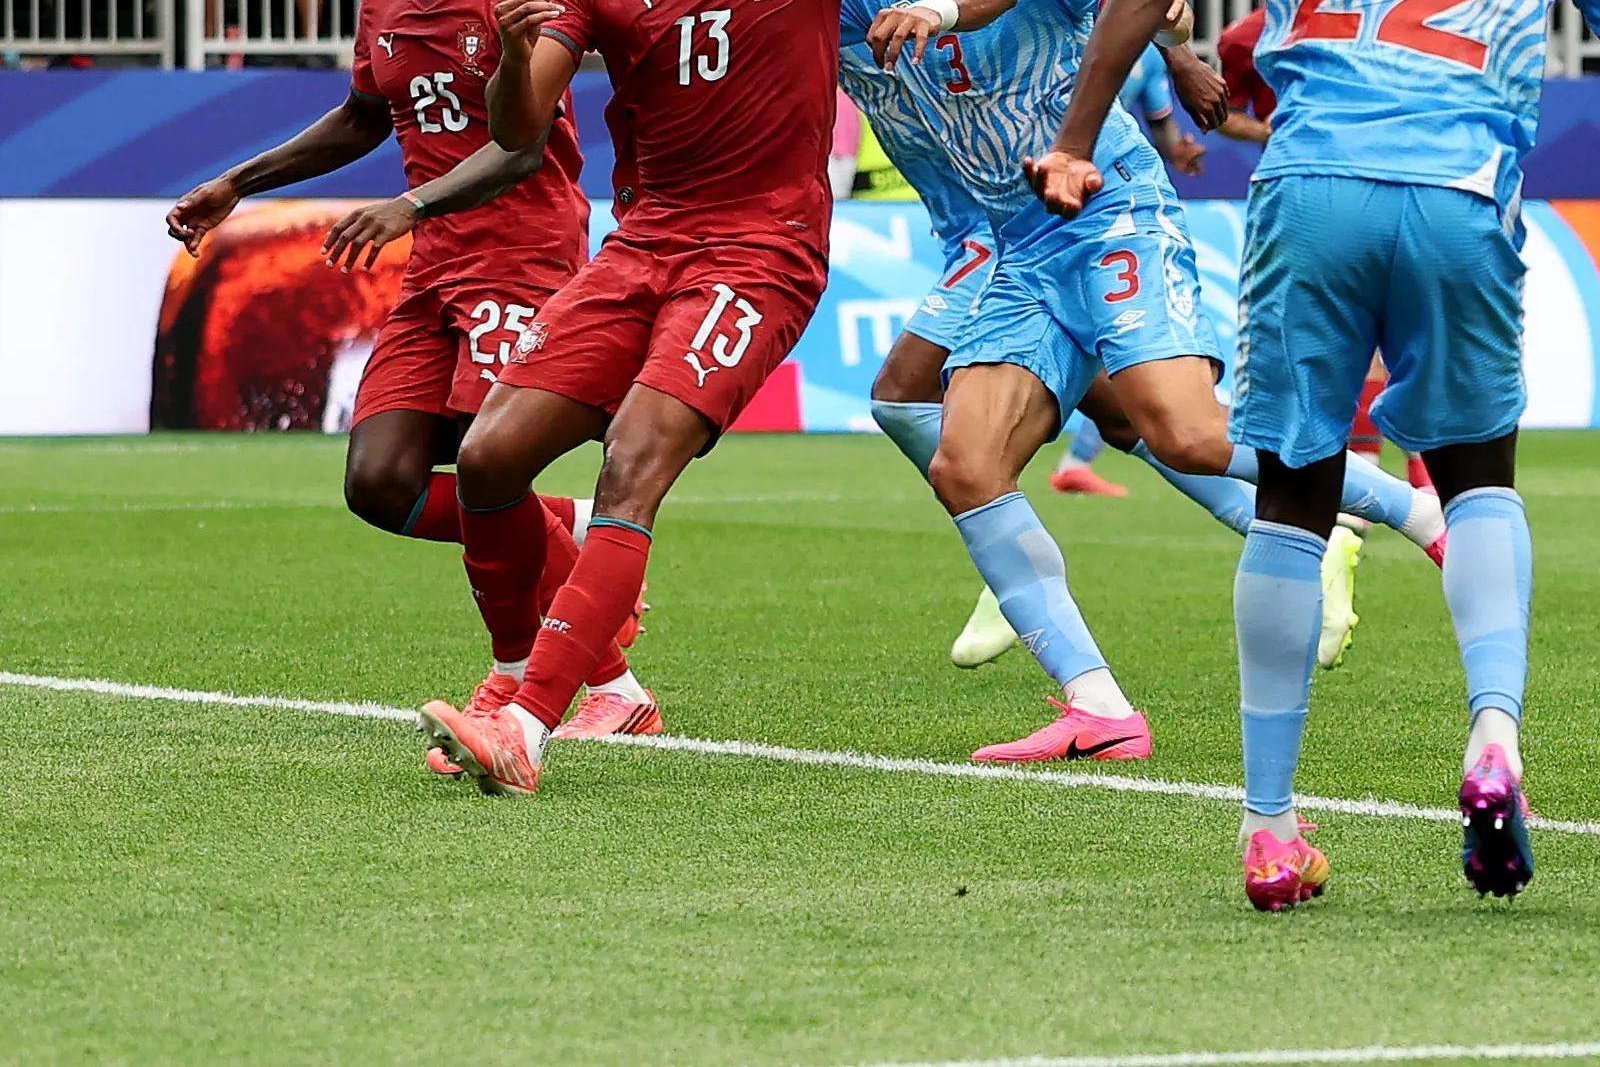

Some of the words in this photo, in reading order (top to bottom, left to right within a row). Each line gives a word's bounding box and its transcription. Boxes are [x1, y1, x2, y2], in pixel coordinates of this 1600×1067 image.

[674, 9, 731, 85] 13
[935, 34, 972, 94] 3
[409, 72, 469, 133] 25
[943, 239, 993, 289] 7
[1099, 249, 1141, 303] 3
[469, 299, 535, 365] 25
[691, 283, 763, 367] 13
